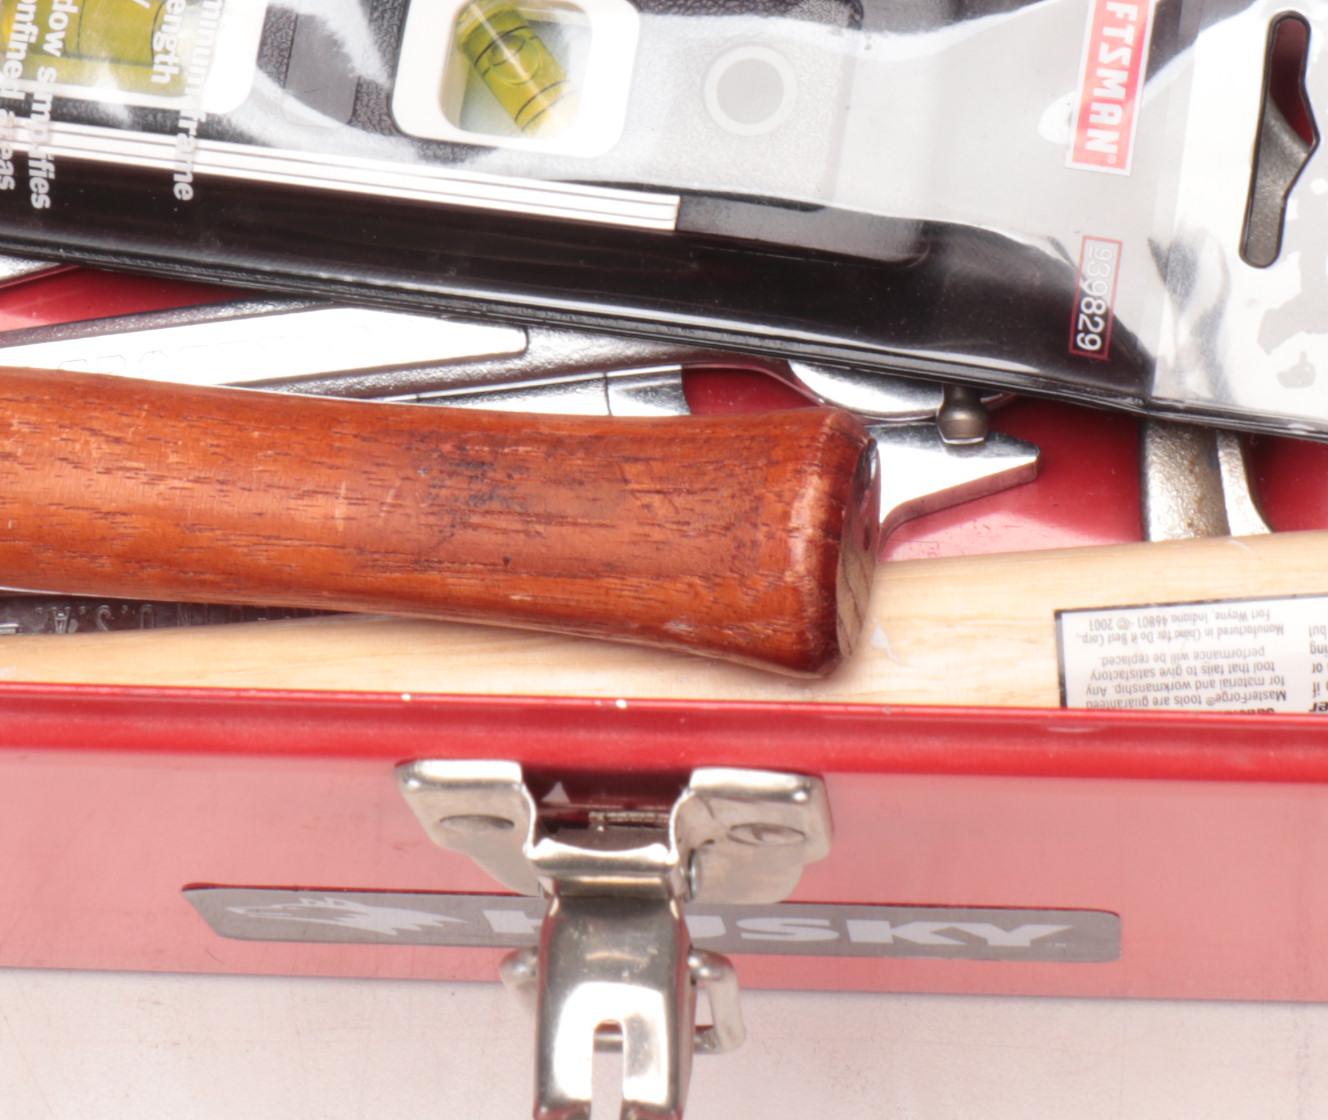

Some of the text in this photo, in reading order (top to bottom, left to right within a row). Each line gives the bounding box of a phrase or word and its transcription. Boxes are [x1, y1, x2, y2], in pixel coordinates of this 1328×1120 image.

[173, 111, 207, 201] frame
[1171, 613, 1208, 626] Indiana
[1251, 608, 1270, 621] Fort
[1140, 631, 1154, 644] Do
[1204, 628, 1214, 639] in
[1216, 624, 1285, 639] Manufactured
[1308, 624, 1326, 641] but
[1107, 633, 1128, 646] Best
[1152, 653, 1166, 665] be
[1170, 652, 1190, 665] will
[1193, 645, 1265, 661] performance
[1090, 661, 1275, 682] tool that fails to give satisfactory
[1312, 662, 1323, 673] or
[1195, 680, 1216, 691] and
[1219, 677, 1265, 688] material
[1269, 675, 1285, 687] for
[1086, 683, 1108, 698] Any
[1312, 681, 1321, 698] if
[1152, 696, 1170, 707] are
[1173, 695, 1202, 707] tools
